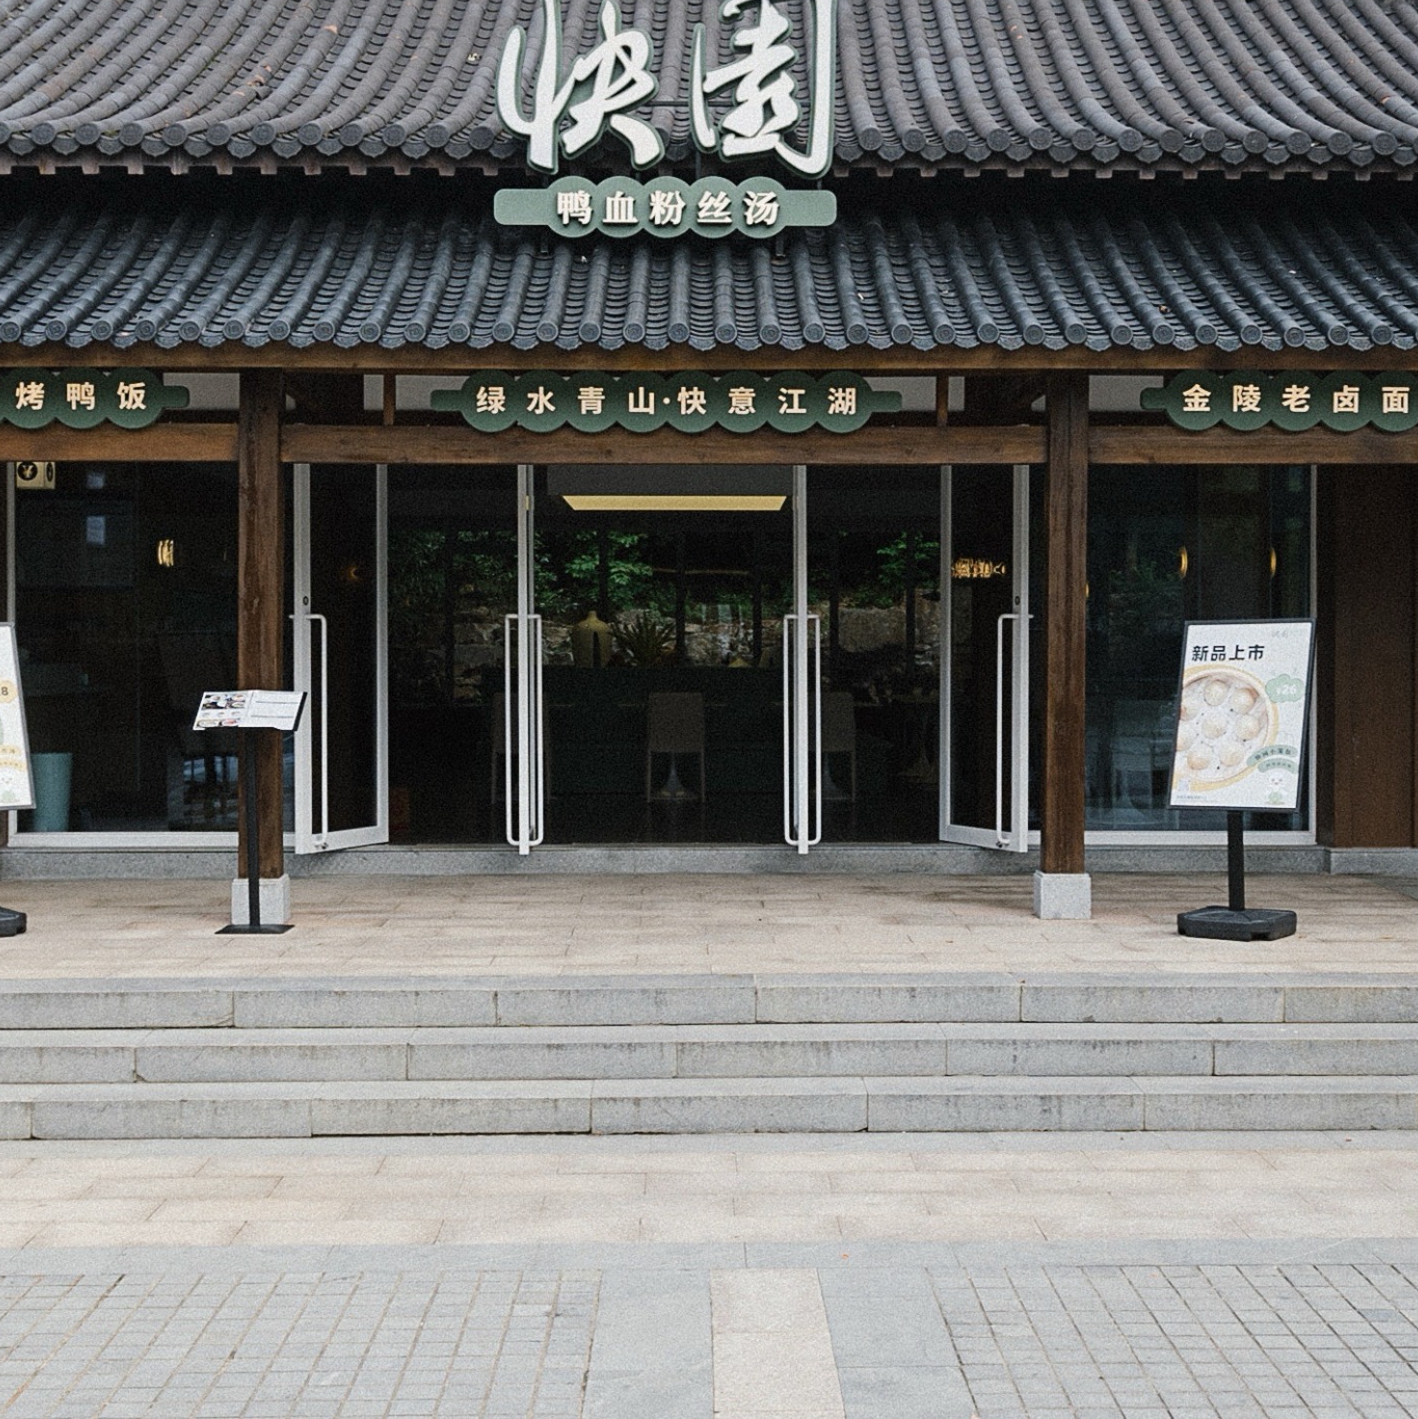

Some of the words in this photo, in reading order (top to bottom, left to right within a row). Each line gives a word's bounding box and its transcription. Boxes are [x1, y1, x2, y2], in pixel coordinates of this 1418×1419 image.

[557, 191, 780, 225] 鸭血粉丝汤
[1182, 384, 1410, 414] 金陵老卤面
[1192, 644, 1265, 662] 新品上市
